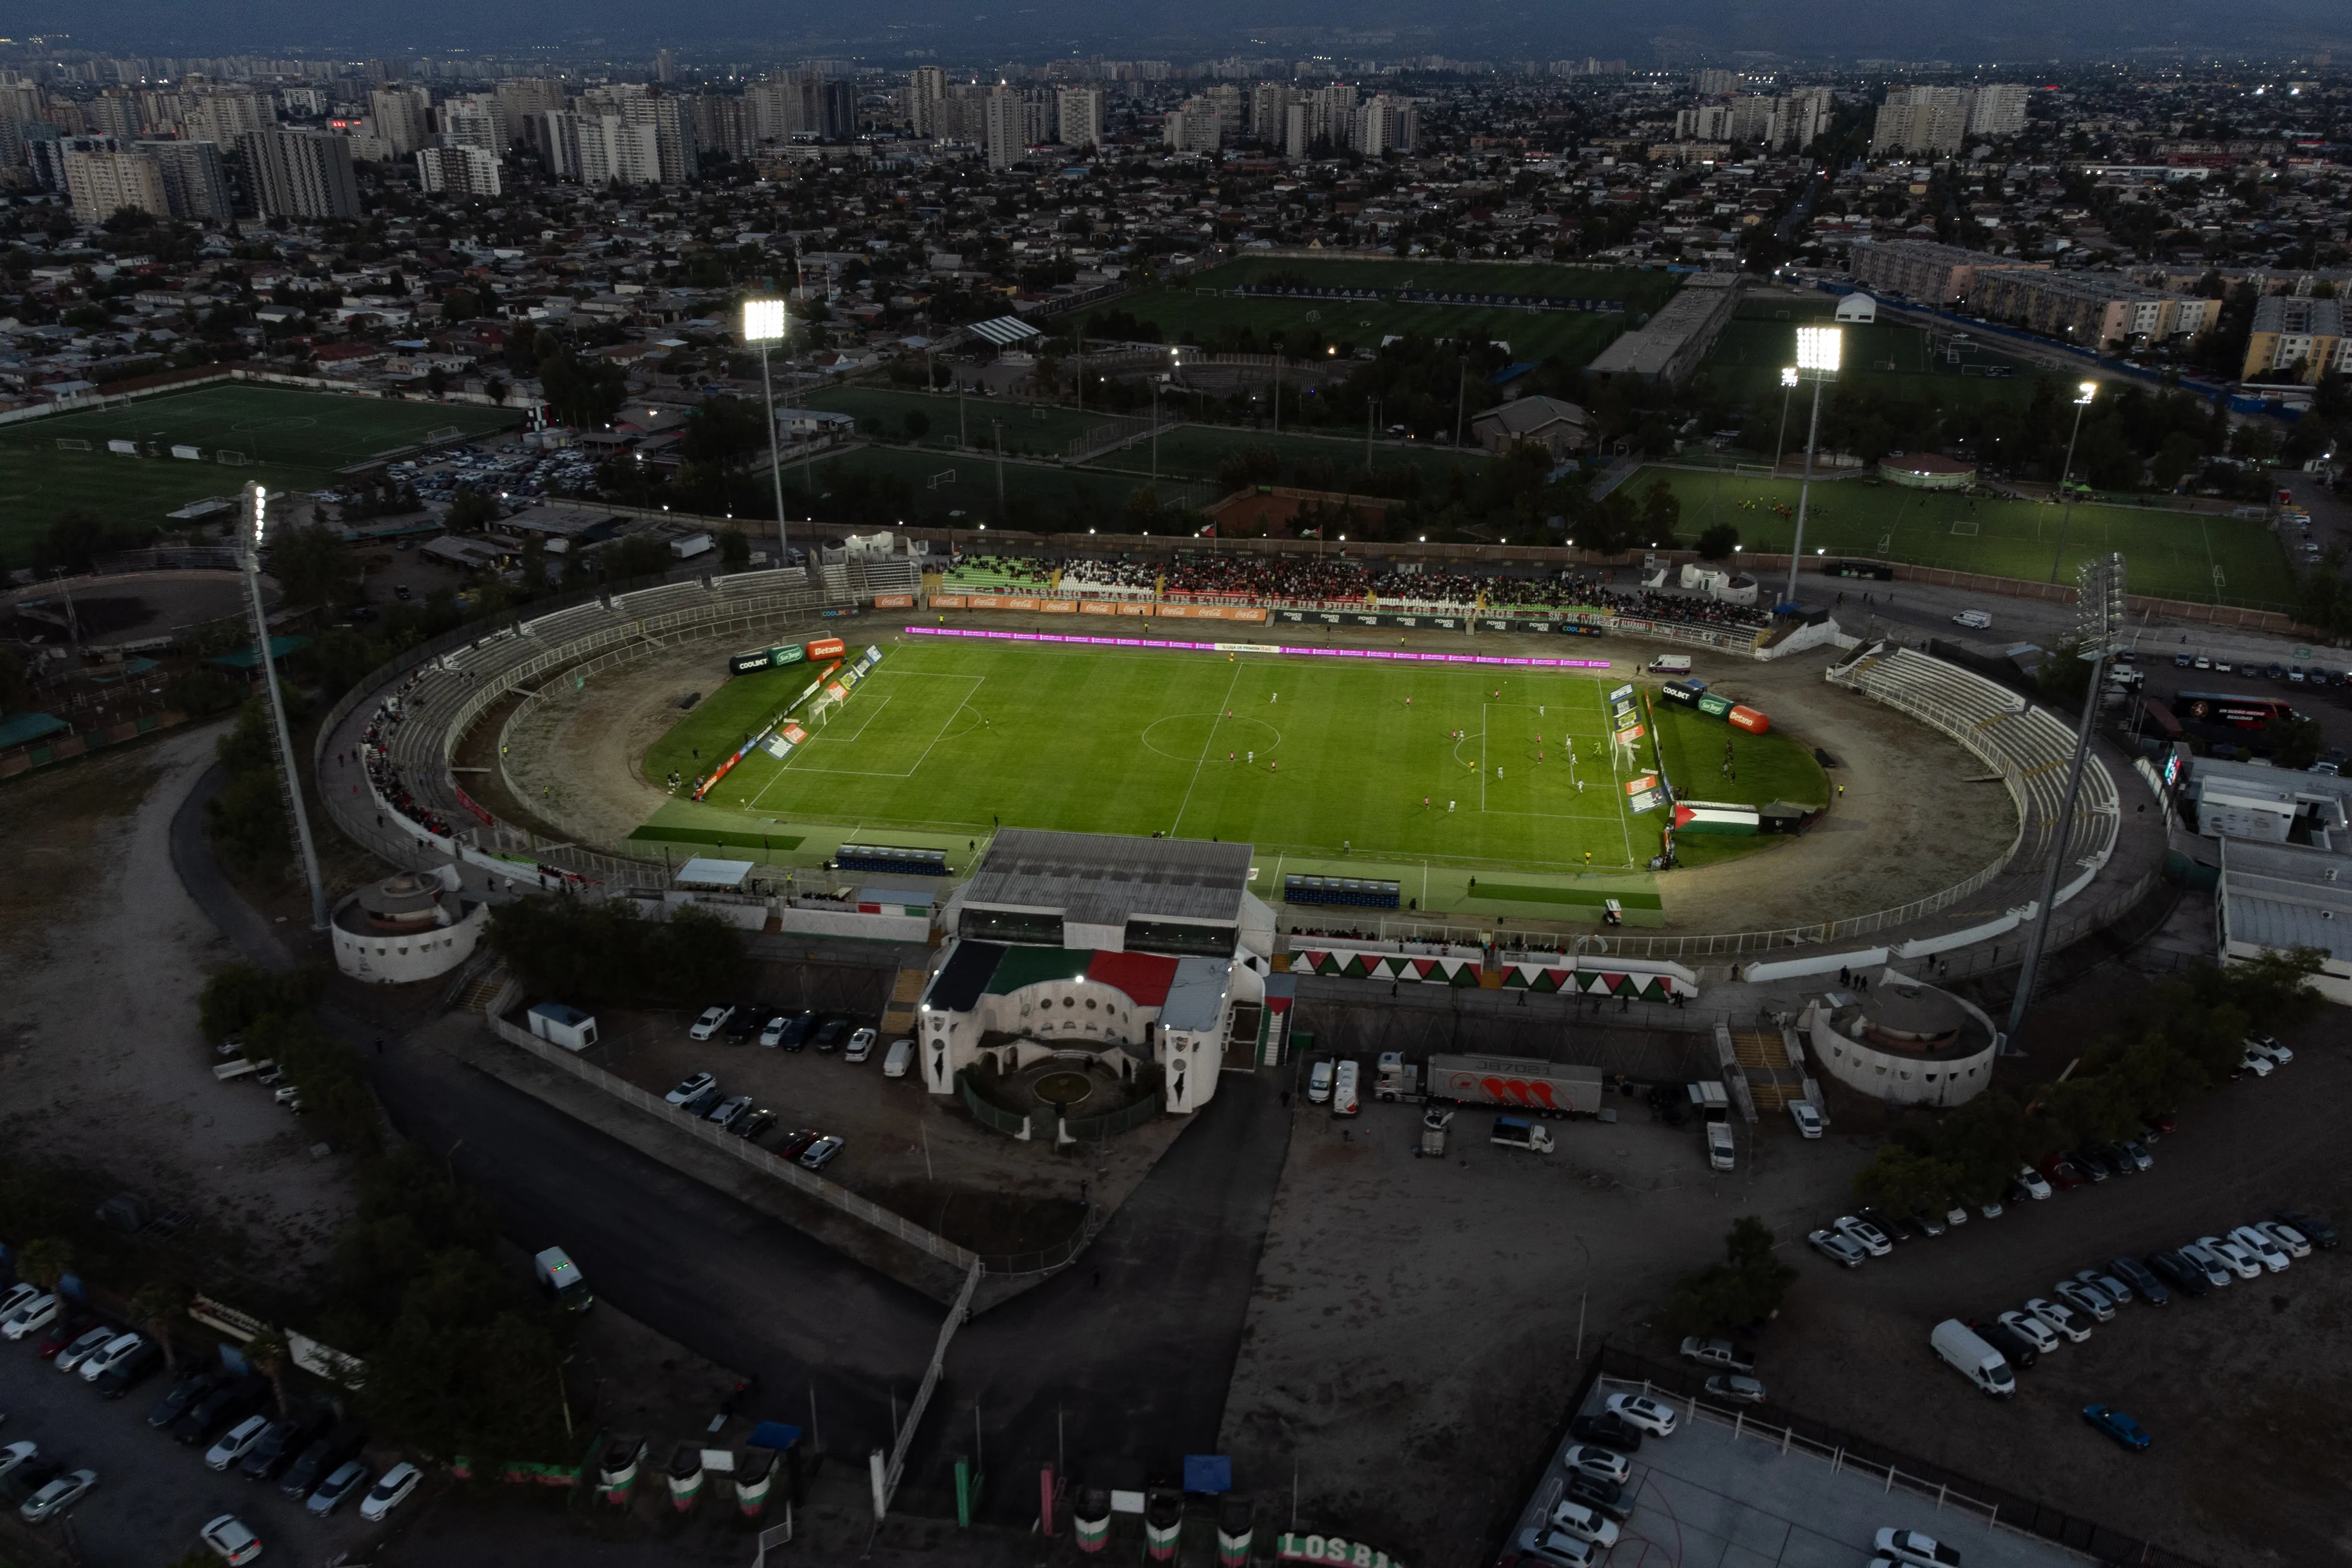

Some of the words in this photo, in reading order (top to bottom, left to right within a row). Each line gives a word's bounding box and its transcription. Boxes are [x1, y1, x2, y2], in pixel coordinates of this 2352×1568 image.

[1255, 598, 1290, 608] TODO
[1297, 600, 1318, 610] UN
[1403, 606, 1431, 616] LOS
[815, 646, 843, 656] Betano
[740, 658, 767, 669] COOLBET
[1663, 687, 1690, 700] COOLBET
[1729, 711, 1753, 726] Betano
[1284, 1532, 1348, 1562] LOS
